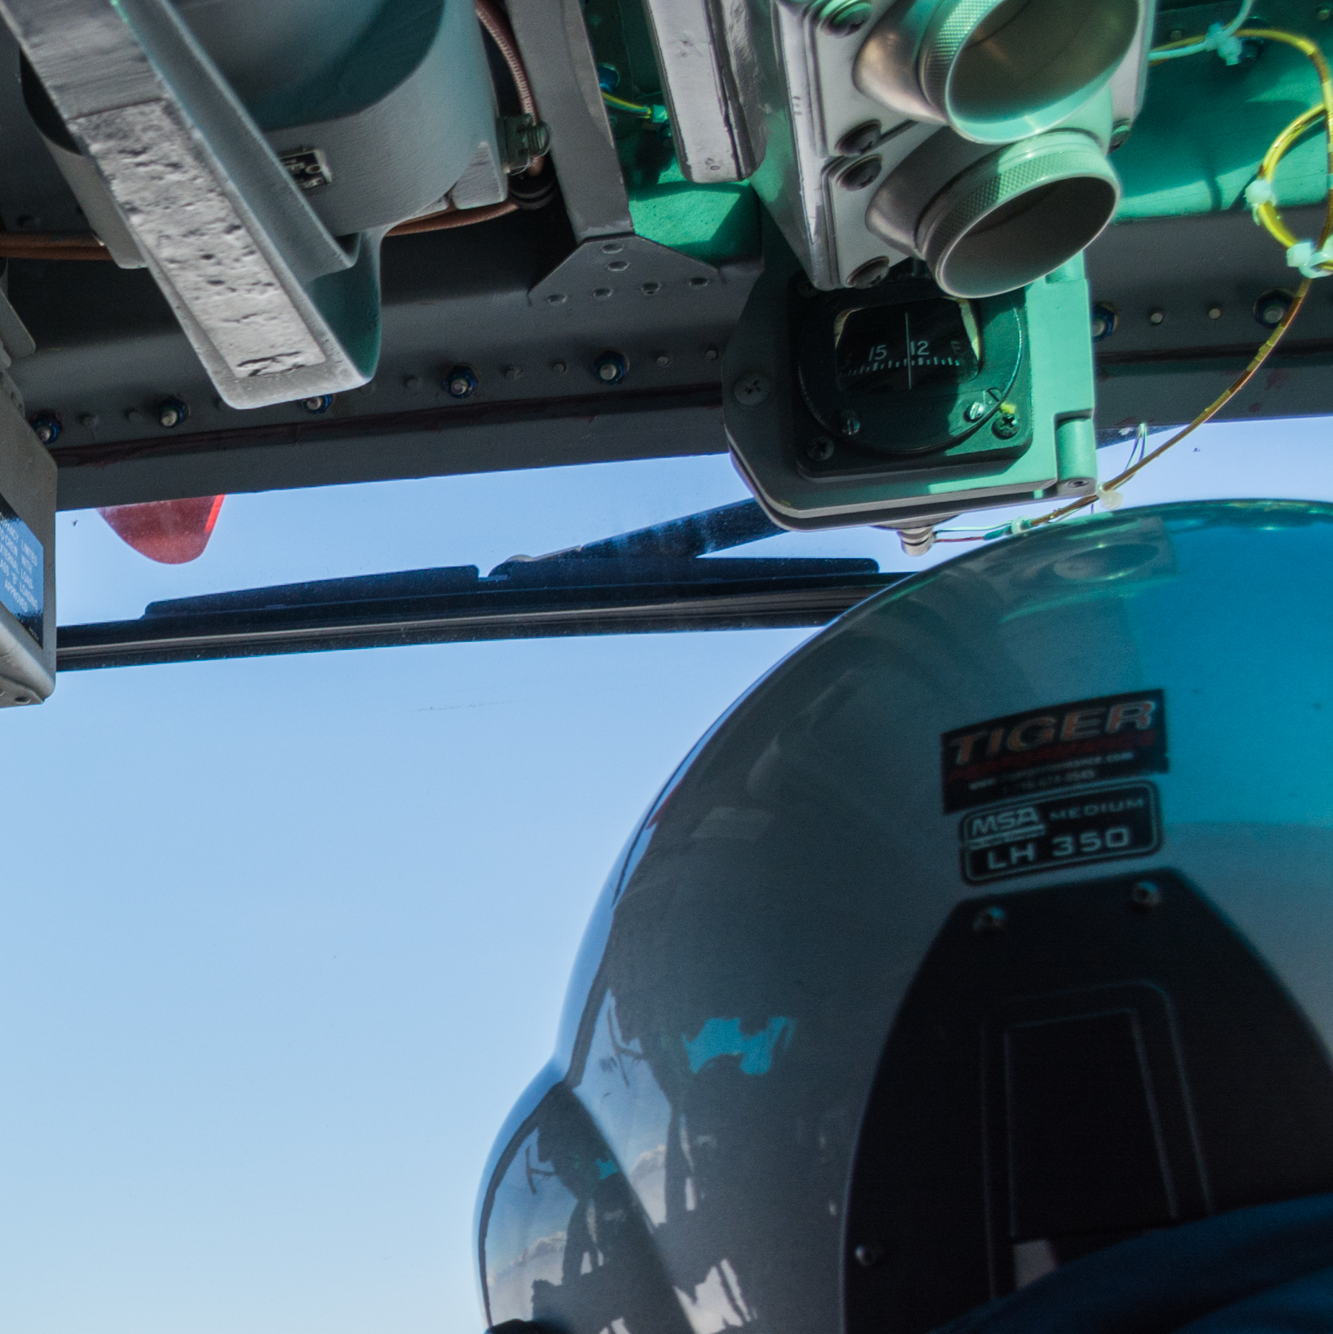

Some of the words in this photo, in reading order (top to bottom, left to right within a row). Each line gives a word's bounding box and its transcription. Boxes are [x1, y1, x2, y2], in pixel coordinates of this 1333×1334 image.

[869, 345, 887, 361] 15
[910, 341, 930, 355] 12
[948, 700, 1157, 764] TIGER
[972, 807, 1040, 835] MSA
[1050, 797, 1144, 820] MEDIUM
[987, 843, 1035, 869] LH
[1052, 826, 1130, 857] 350
